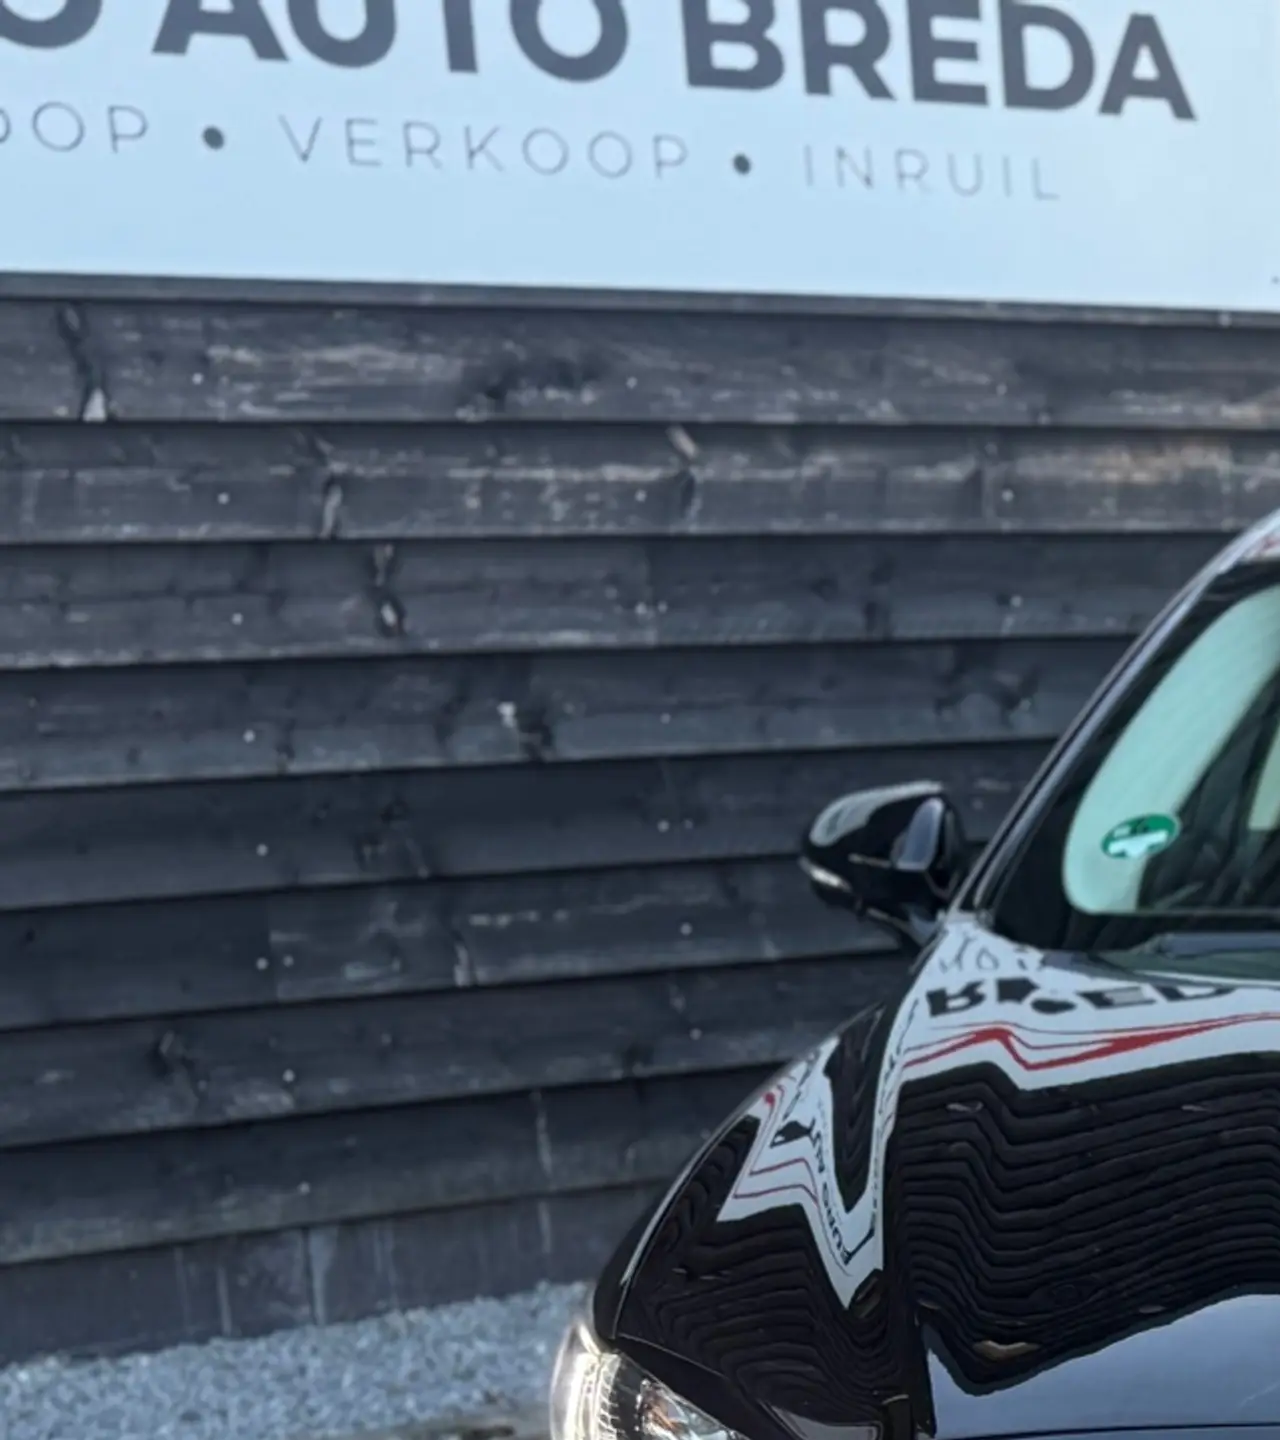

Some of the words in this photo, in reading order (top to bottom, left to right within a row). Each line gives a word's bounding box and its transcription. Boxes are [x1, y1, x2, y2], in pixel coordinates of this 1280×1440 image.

[679, 0, 1198, 122] BREDA
[0, 101, 149, 153] OP
[278, 114, 688, 181] VERKOOP
[803, 144, 1060, 201] INRUIL
